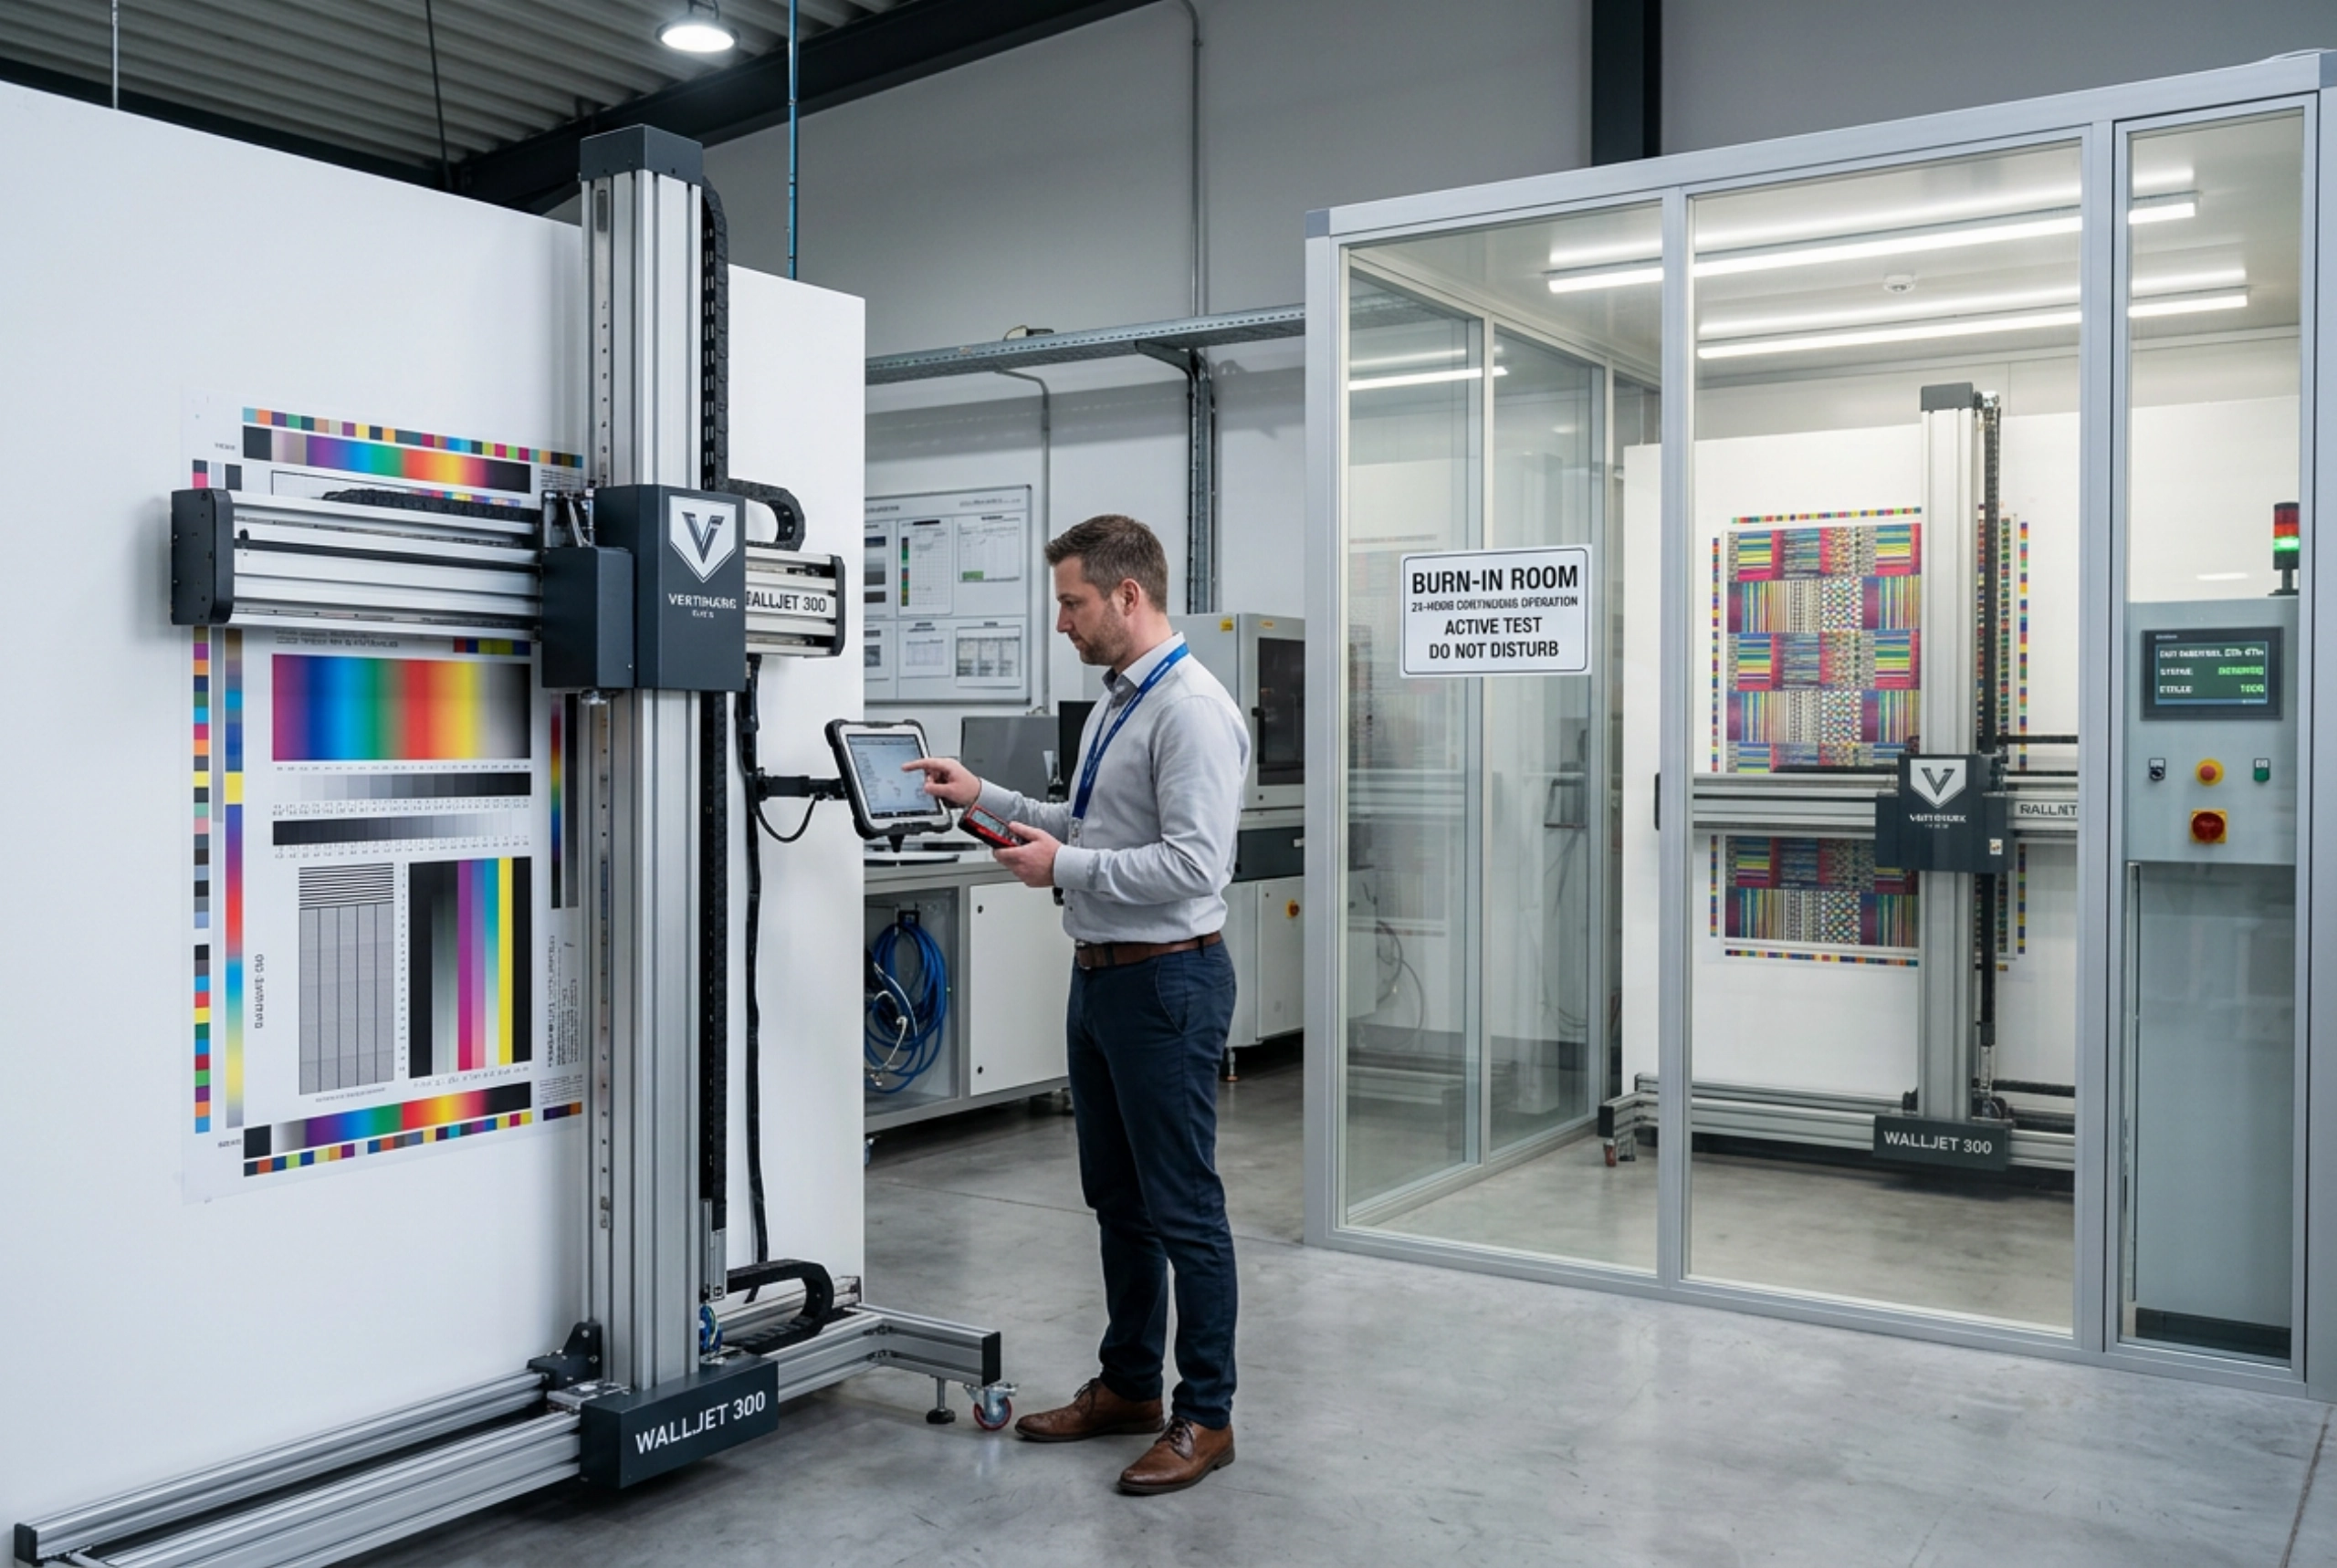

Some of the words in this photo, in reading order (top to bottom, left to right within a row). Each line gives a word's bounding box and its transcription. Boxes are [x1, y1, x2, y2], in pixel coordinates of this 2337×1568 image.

[1411, 569, 1503, 594] BURN-IN
[1511, 565, 1578, 590] ROOM
[803, 597, 827, 612] 300
[1521, 596, 1578, 609] OPERATION
[1444, 618, 1499, 636] ACTIVE
[1504, 617, 1543, 633] TEST
[1429, 643, 1451, 659] DO
[1455, 643, 1486, 659] NOT
[1490, 641, 1558, 658] DISTURB
[1883, 1131, 1960, 1151] WALLJET
[1964, 1139, 1993, 1155] 300
[635, 1403, 729, 1455] WALLJET
[732, 1390, 766, 1420] 300
